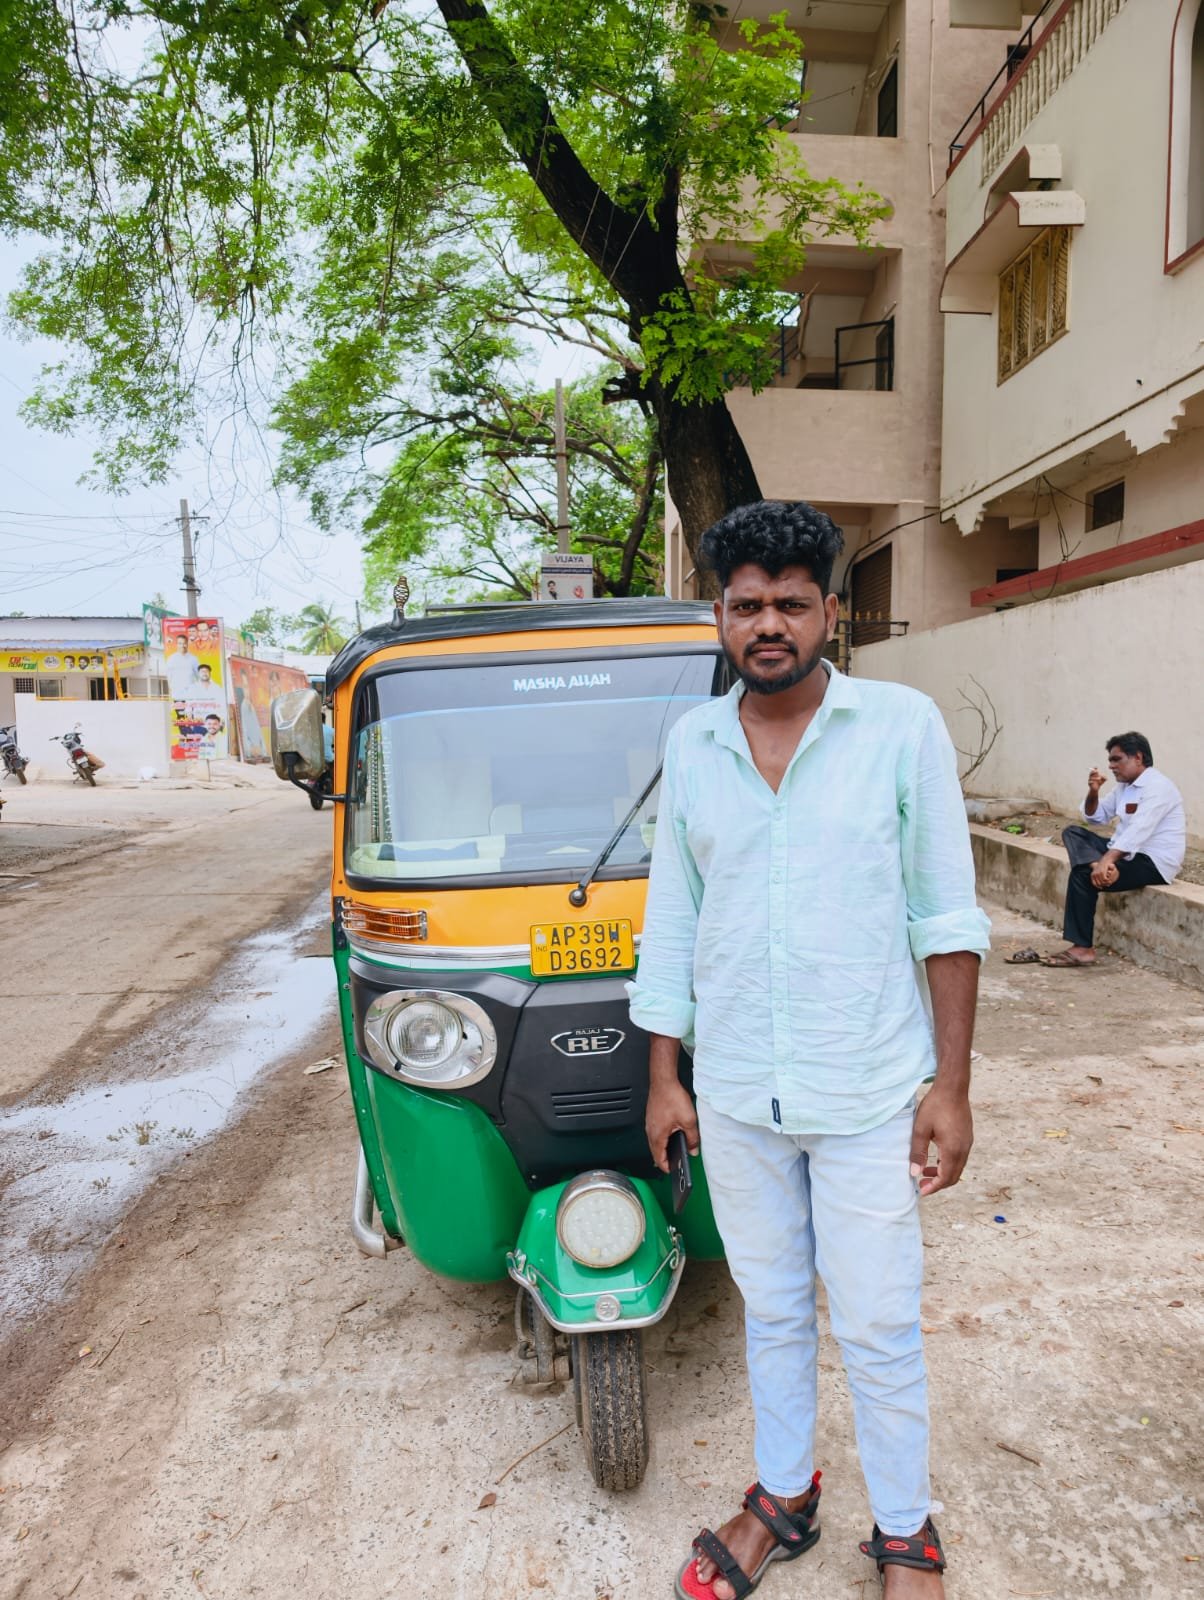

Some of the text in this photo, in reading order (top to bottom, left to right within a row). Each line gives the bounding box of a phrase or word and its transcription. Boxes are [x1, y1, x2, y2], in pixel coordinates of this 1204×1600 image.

[513, 673, 611, 691] MASHA ALLAH
[551, 923, 620, 947] AP39W
[550, 947, 622, 971] D3692
[568, 1036, 609, 1052] RE
